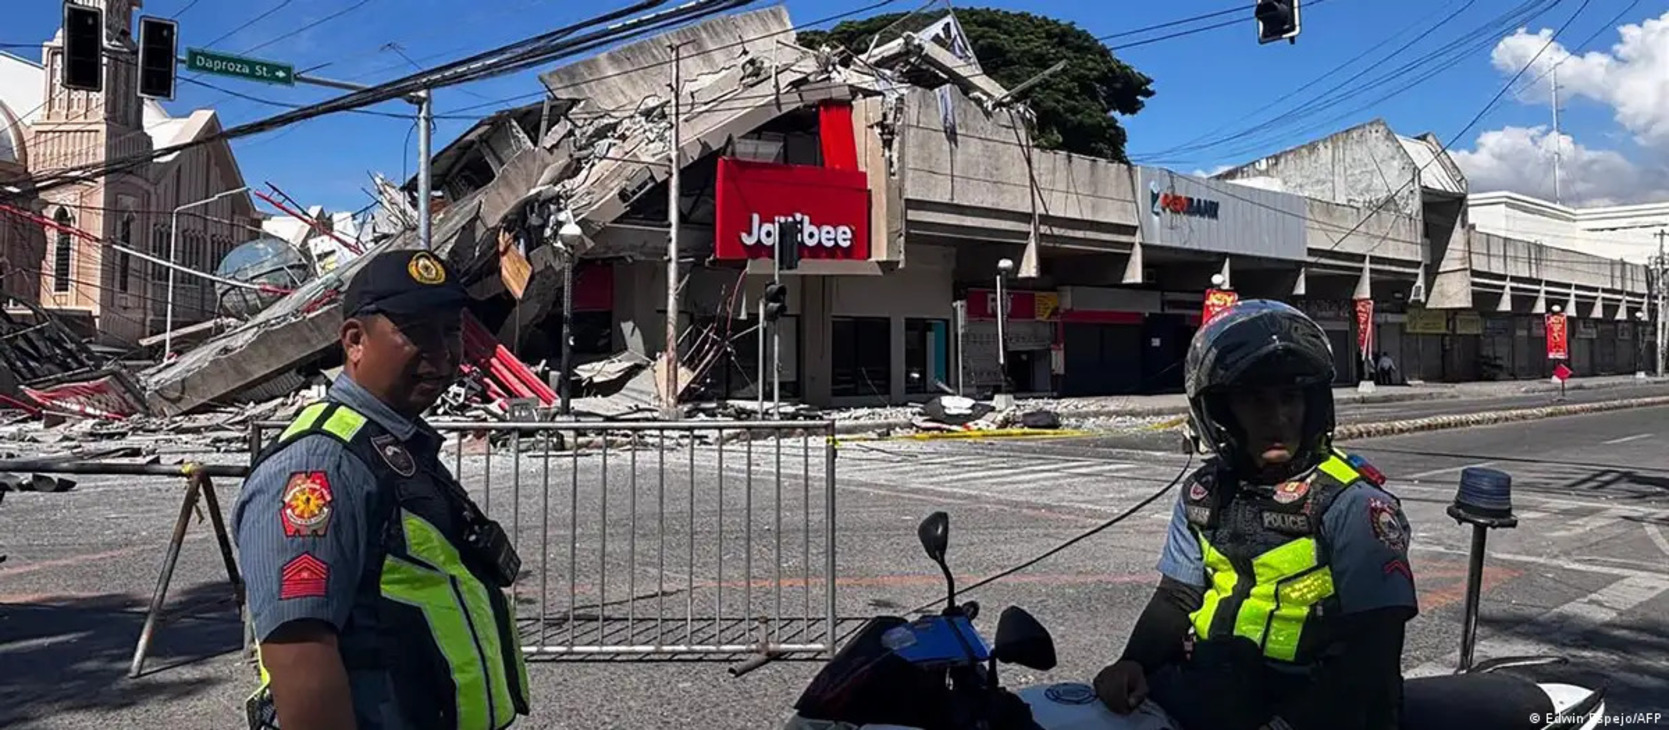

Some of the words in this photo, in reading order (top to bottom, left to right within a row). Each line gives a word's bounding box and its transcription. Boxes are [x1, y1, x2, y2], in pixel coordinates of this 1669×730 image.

[195, 55, 250, 74] Daproza
[255, 65, 272, 78] St.
[1263, 512, 1308, 529] POLICE
